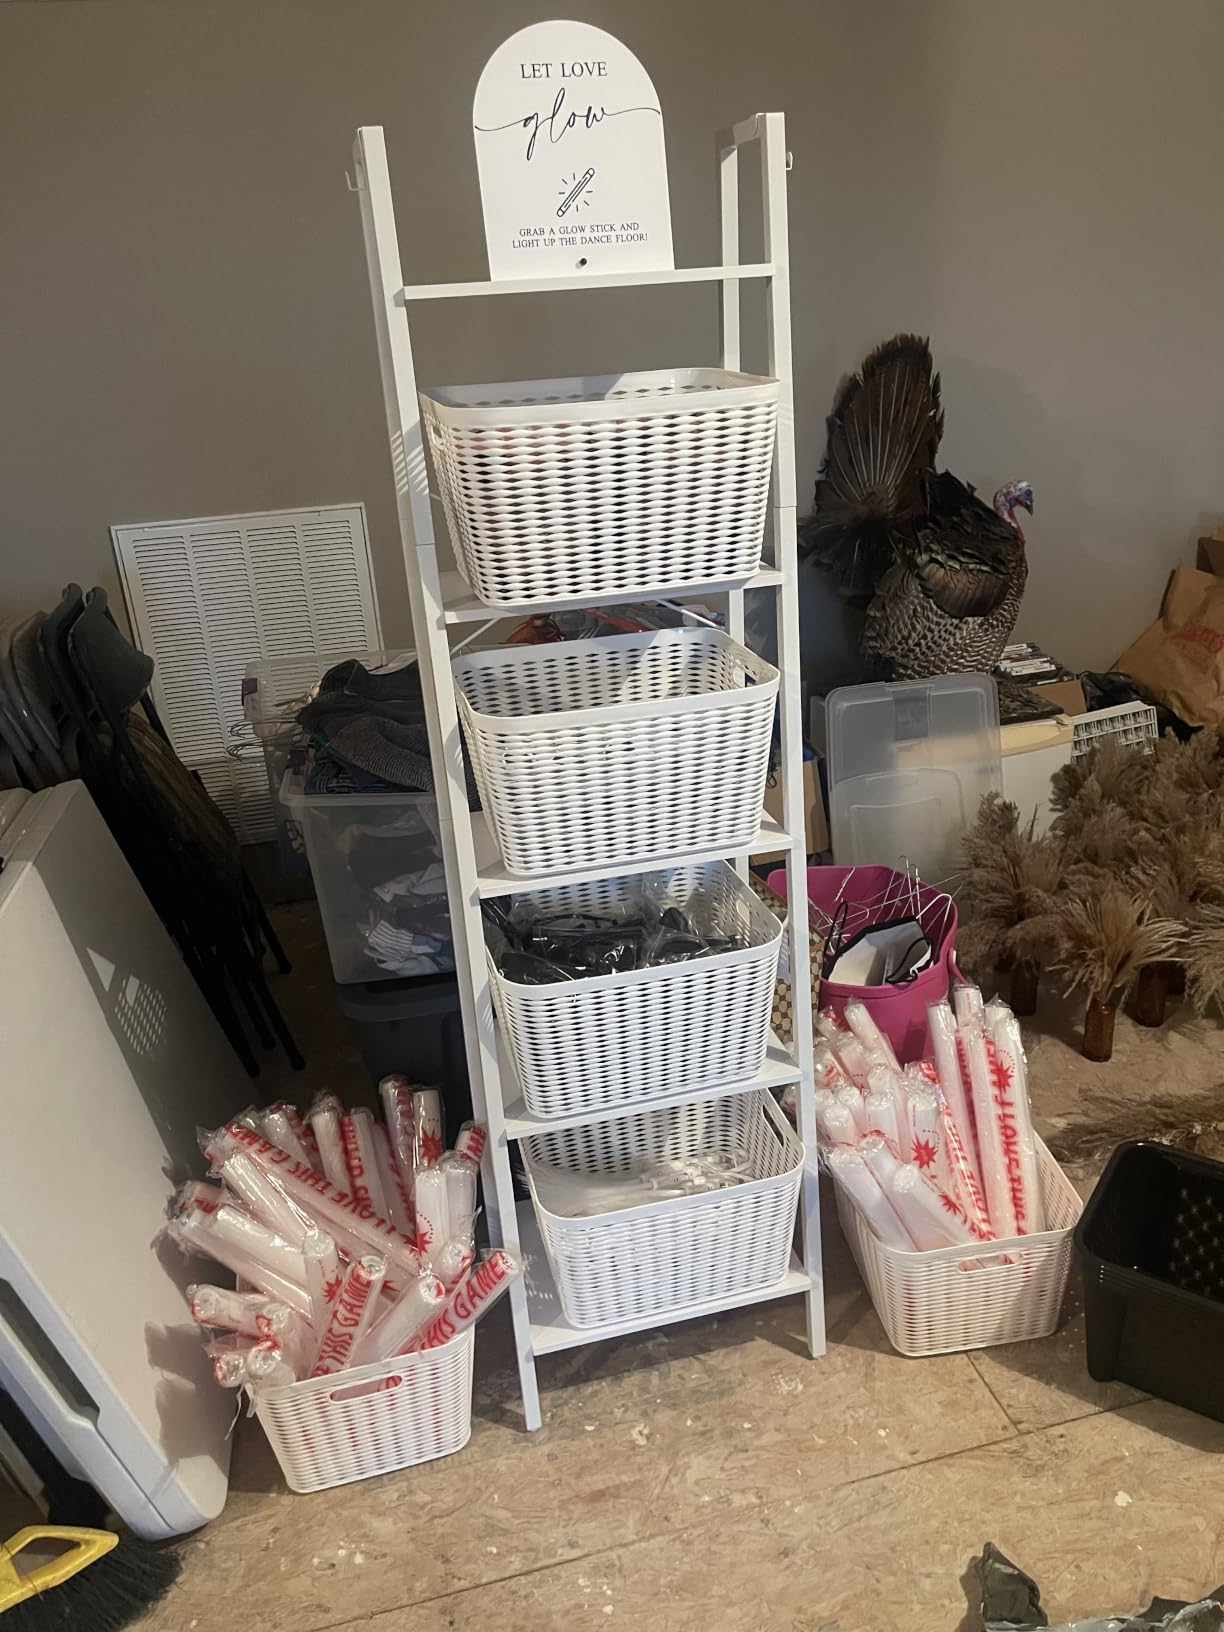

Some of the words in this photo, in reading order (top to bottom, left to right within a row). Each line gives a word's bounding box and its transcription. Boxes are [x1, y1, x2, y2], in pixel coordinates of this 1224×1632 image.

[520, 63, 553, 79] LET
[560, 61, 608, 78] LOVE
[475, 87, 661, 161] glow
[512, 239, 541, 248] LIGHT
[543, 238, 556, 247] UP
[559, 236, 578, 246] THE
[580, 234, 613, 245] DANCE
[615, 233, 649, 243] FLOOR!
[519, 227, 546, 237] GRAB
[548, 227, 556, 236] A
[559, 225, 587, 235] GLOW
[589, 223, 616, 234] STICK
[619, 222, 640, 232] AND
[287, 1160, 333, 1195] THIS
[319, 1327, 354, 1366] THIS
